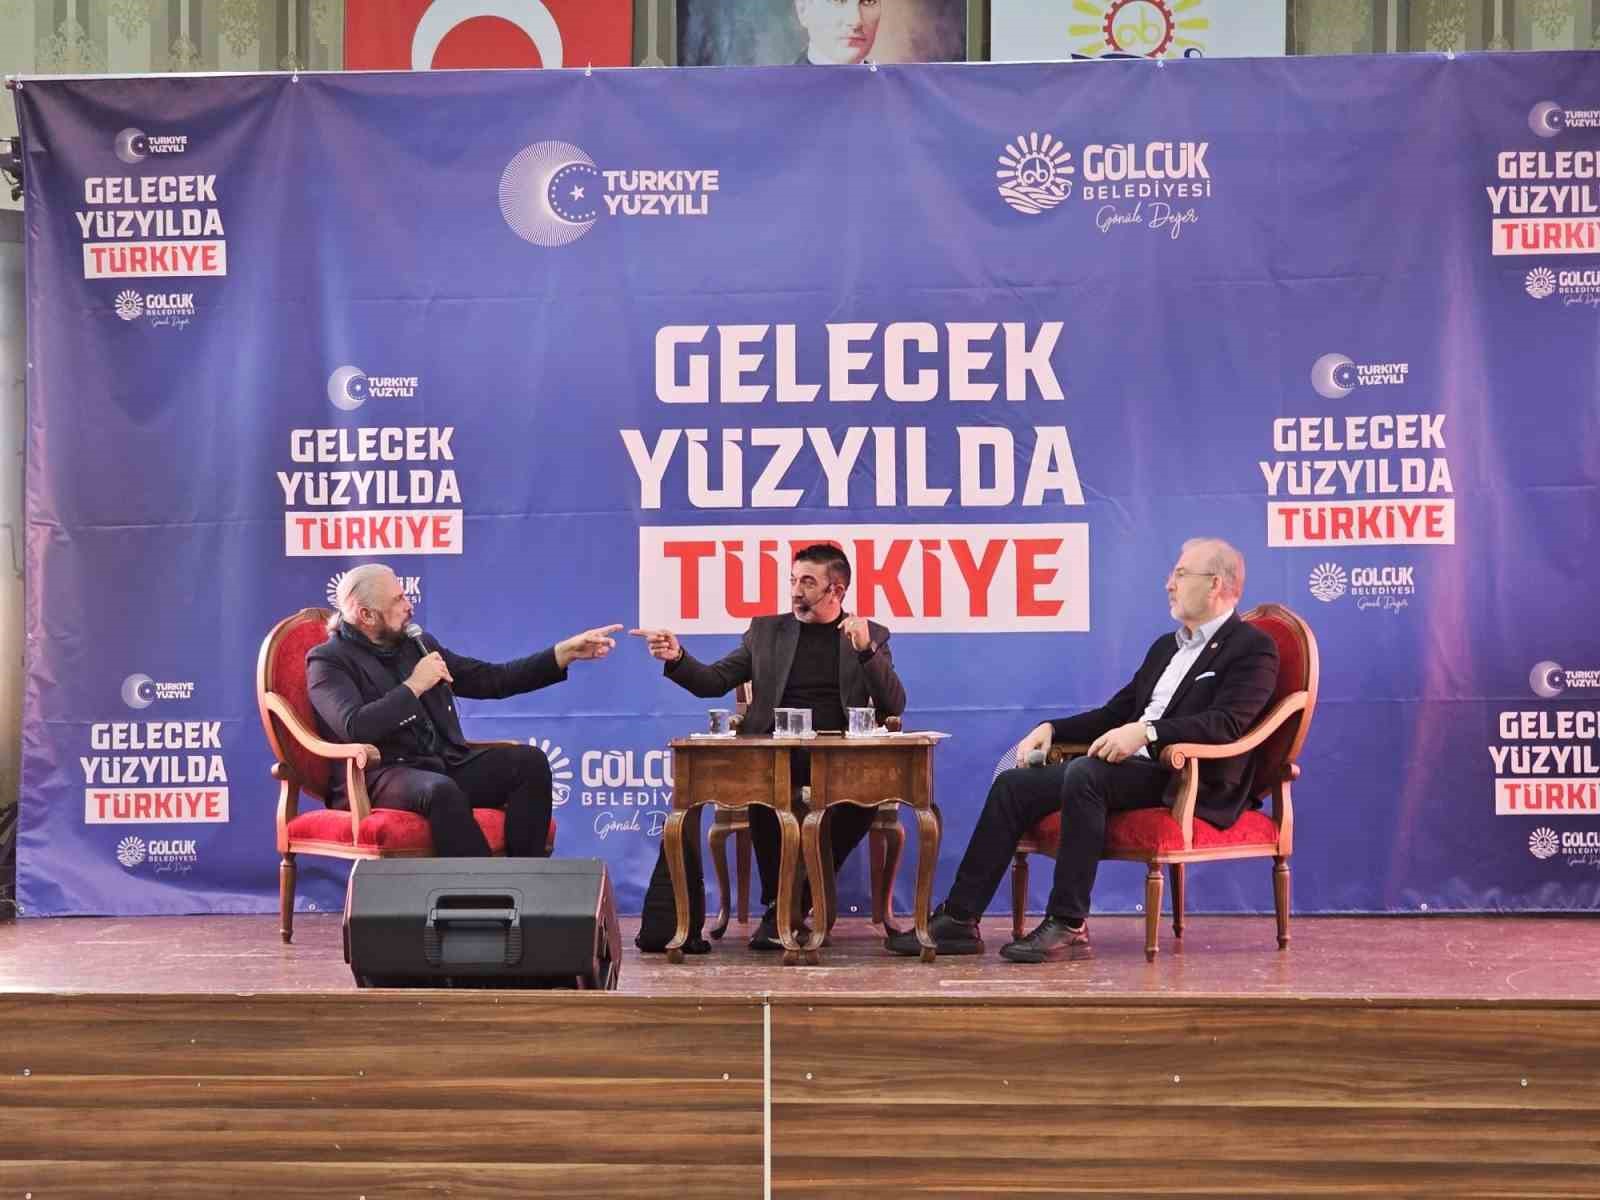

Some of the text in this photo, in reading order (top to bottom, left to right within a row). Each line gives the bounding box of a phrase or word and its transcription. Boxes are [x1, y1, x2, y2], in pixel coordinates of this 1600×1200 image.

[1083, 142, 1210, 182] GÖLCÜK
[1498, 152, 1600, 178] GELEC
[85, 175, 216, 204] GELECEK
[602, 170, 720, 192] TÜRKİYE
[1083, 180, 1211, 200] BELEDİYESİ
[1486, 185, 1600, 214] YÜZYIL
[76, 208, 224, 238] YÜZYILDA
[1501, 222, 1600, 250] TÜRKİ
[90, 246, 217, 274] TÜRKİYE
[655, 322, 1064, 404] GELECEK
[291, 427, 454, 462] GELECEK
[1273, 414, 1446, 452] GELECEK
[620, 426, 1086, 509] YÜZYILDA
[1259, 458, 1454, 496] YÜZYILDA
[277, 470, 462, 505] YÜZYILDA
[296, 516, 452, 550] TÜRKİYE
[1278, 506, 1444, 540] TÜRKİYE
[92, 722, 222, 750] GELECEK
[1500, 711, 1600, 739] GELEC
[80, 756, 228, 784] YÜZYILDA
[582, 750, 674, 788] GÖLC
[1488, 746, 1600, 774] YÜZYIL
[94, 792, 220, 818] TÜRKİYE
[582, 789, 672, 806] BELEDİY
[1504, 784, 1600, 809] TÜRKİ
